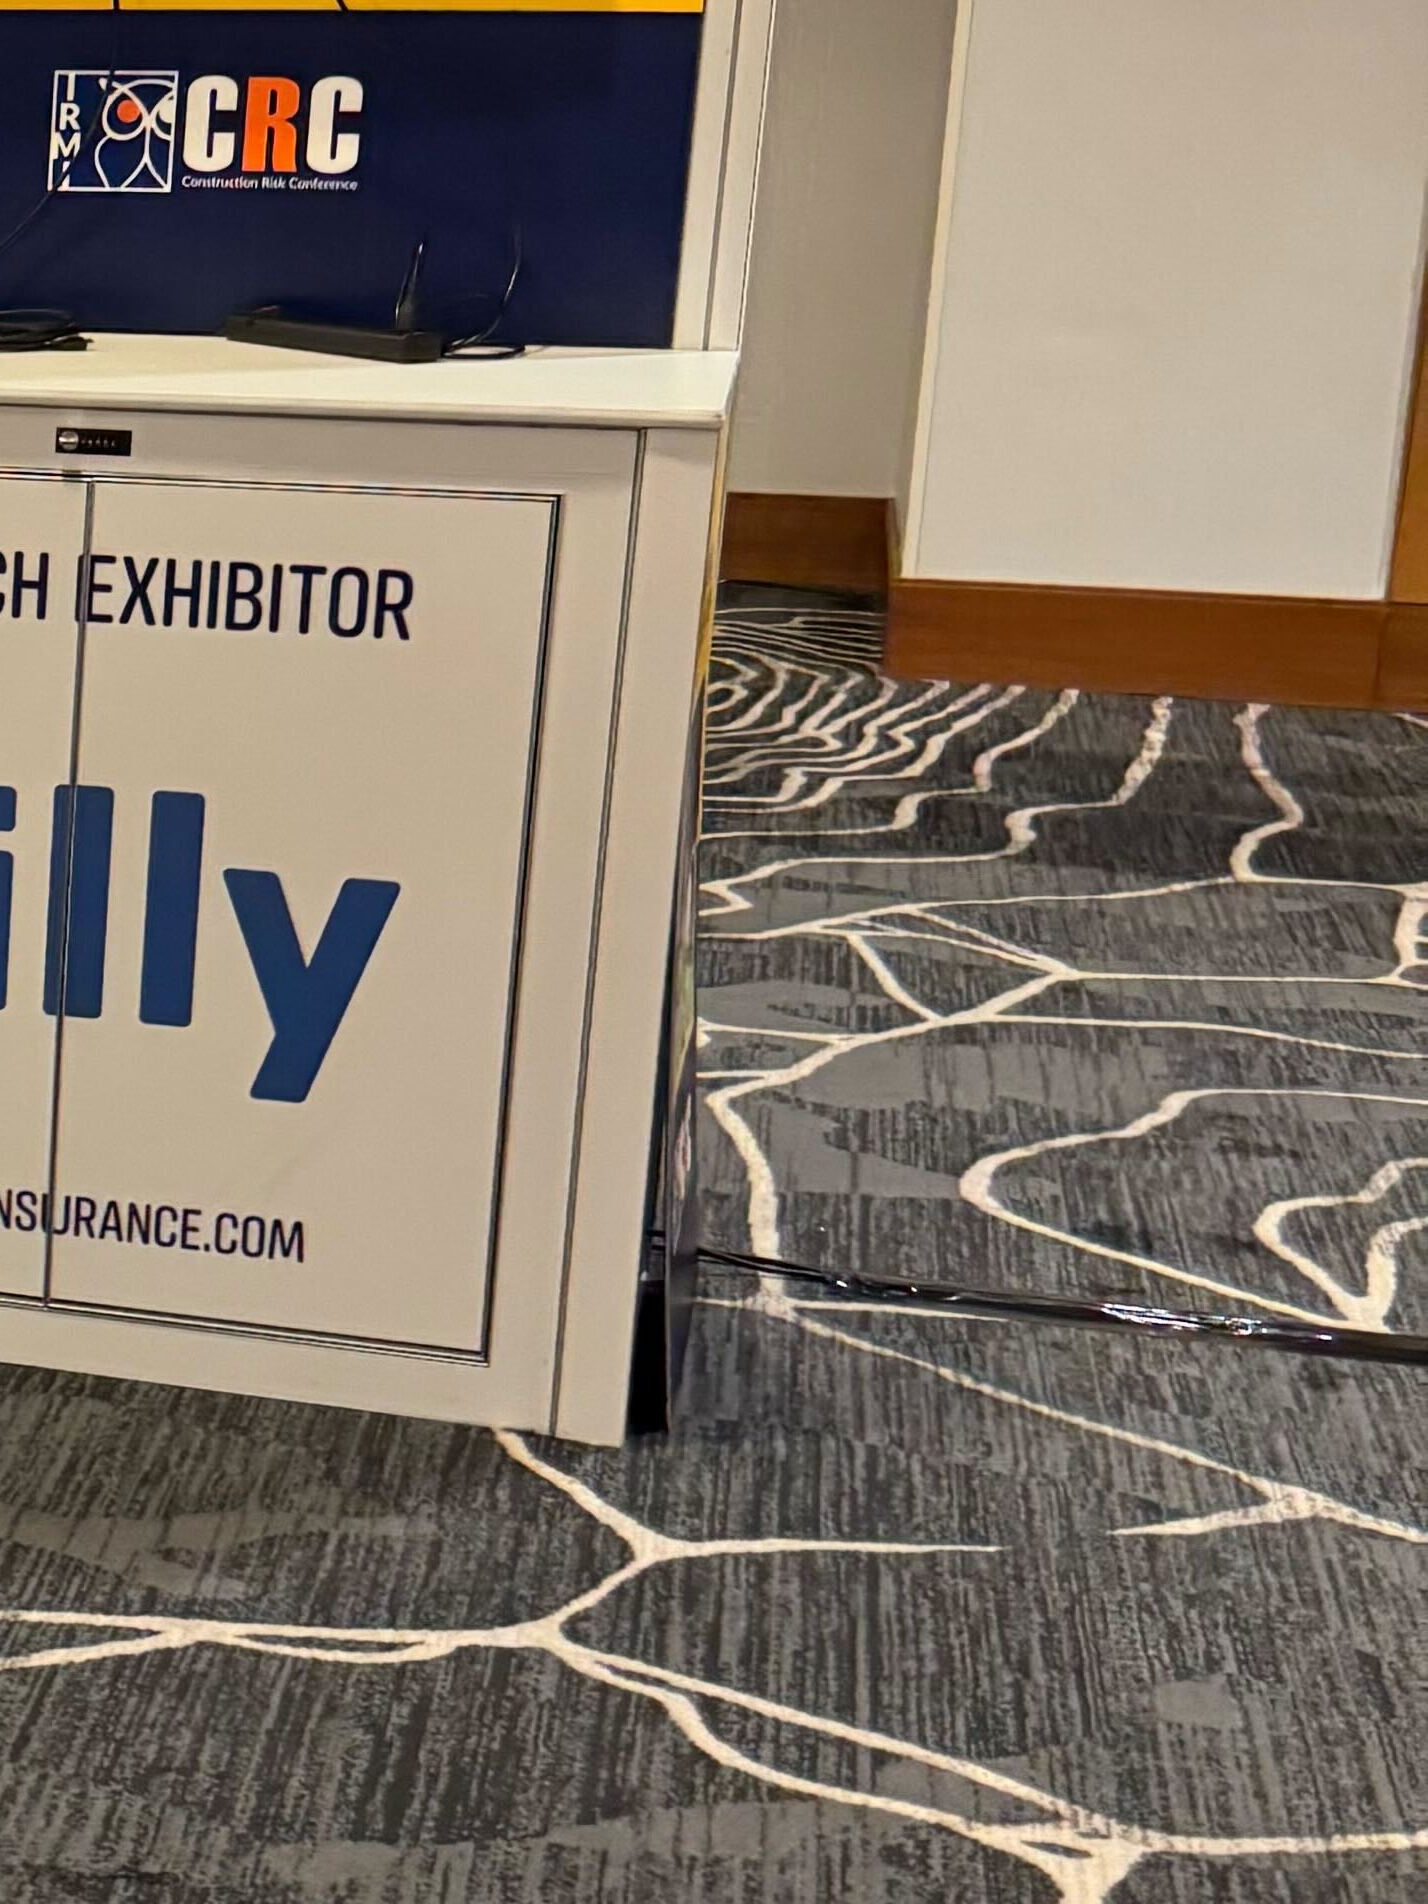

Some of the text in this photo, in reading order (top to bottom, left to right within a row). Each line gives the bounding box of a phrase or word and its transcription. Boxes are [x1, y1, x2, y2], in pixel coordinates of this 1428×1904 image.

[182, 74, 363, 174] CRC
[181, 175, 258, 190] Construction
[75, 553, 414, 641] EXHIBITOR
